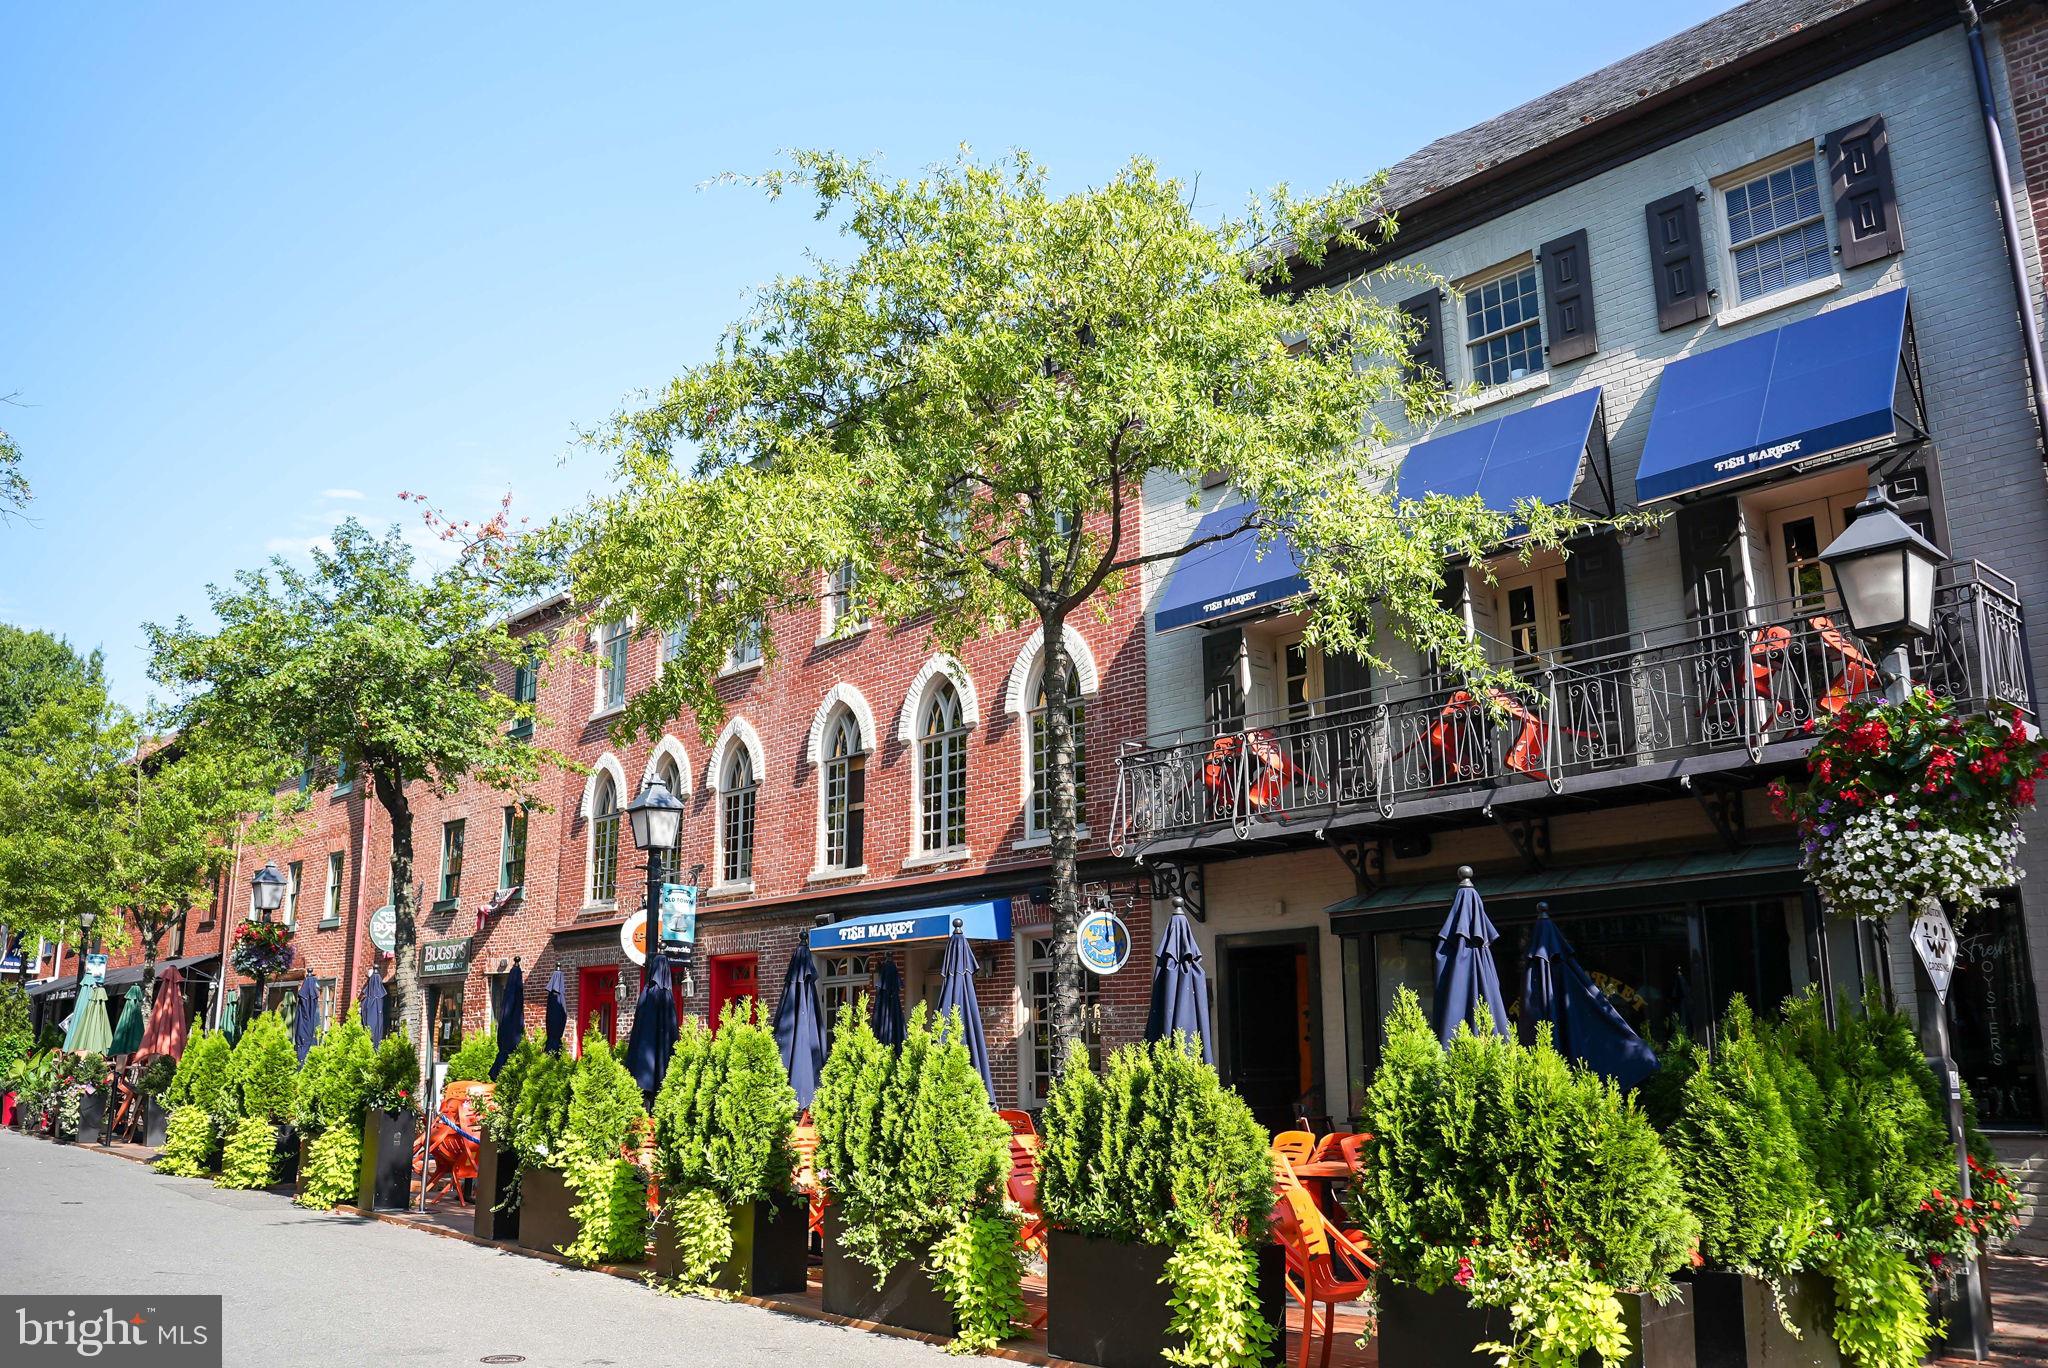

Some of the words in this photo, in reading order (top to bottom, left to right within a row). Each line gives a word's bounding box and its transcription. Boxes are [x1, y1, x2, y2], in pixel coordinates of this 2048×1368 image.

[1714, 456, 1745, 471] FISH
[1748, 440, 1801, 462] MARKET
[1203, 600, 1223, 612] FISH
[1224, 591, 1257, 607] MARKET
[839, 926, 865, 940] FISH
[868, 920, 915, 940] MARKET
[424, 941, 467, 963] BUGSY'S
[1960, 931, 2009, 963] Fresh
[1981, 961, 2003, 1066] OYSTERS
